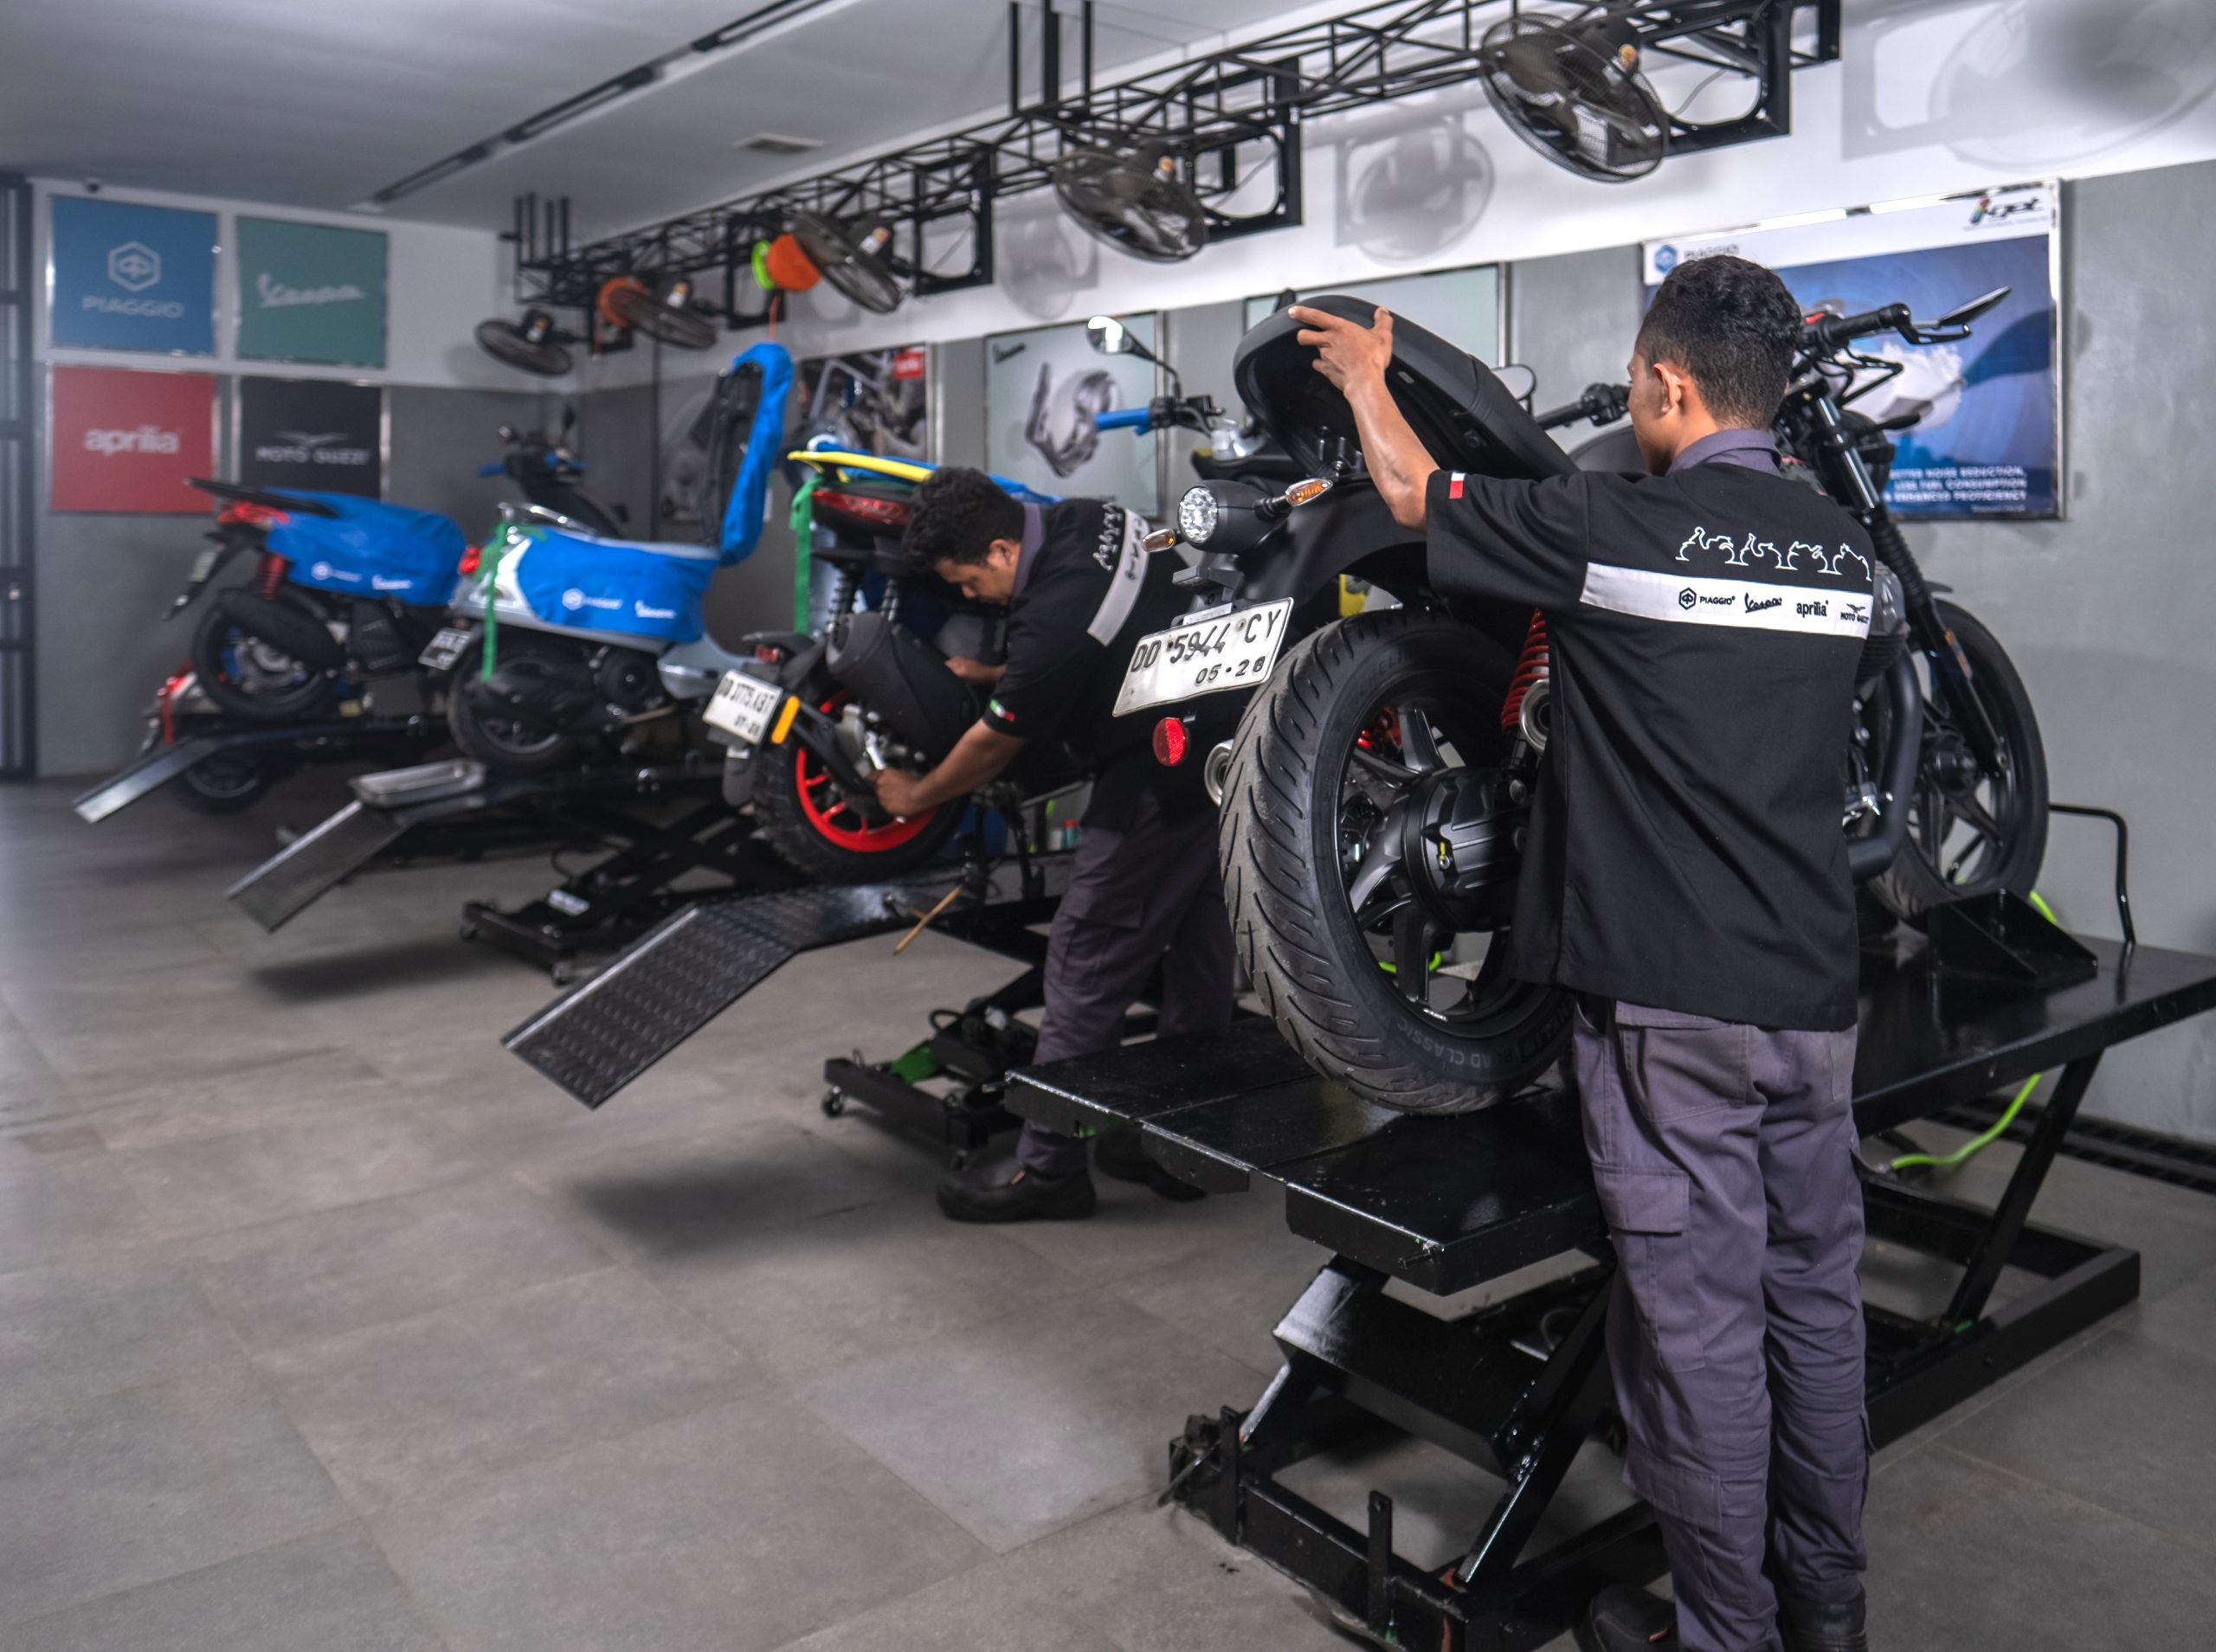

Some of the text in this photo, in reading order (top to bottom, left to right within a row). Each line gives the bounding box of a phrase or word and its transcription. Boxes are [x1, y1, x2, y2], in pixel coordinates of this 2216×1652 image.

[82, 295, 184, 318] PIAGGIO
[84, 426, 180, 455] aprilia
[255, 446, 310, 463] MOTO
[1744, 593, 1782, 613] Vespa
[1796, 601, 1828, 618] aprilia
[1131, 640, 1162, 672] DD
[1169, 622, 1231, 664] 5944
[1245, 609, 1281, 643] CY
[1396, 1016, 1466, 1065] CLASSIC
